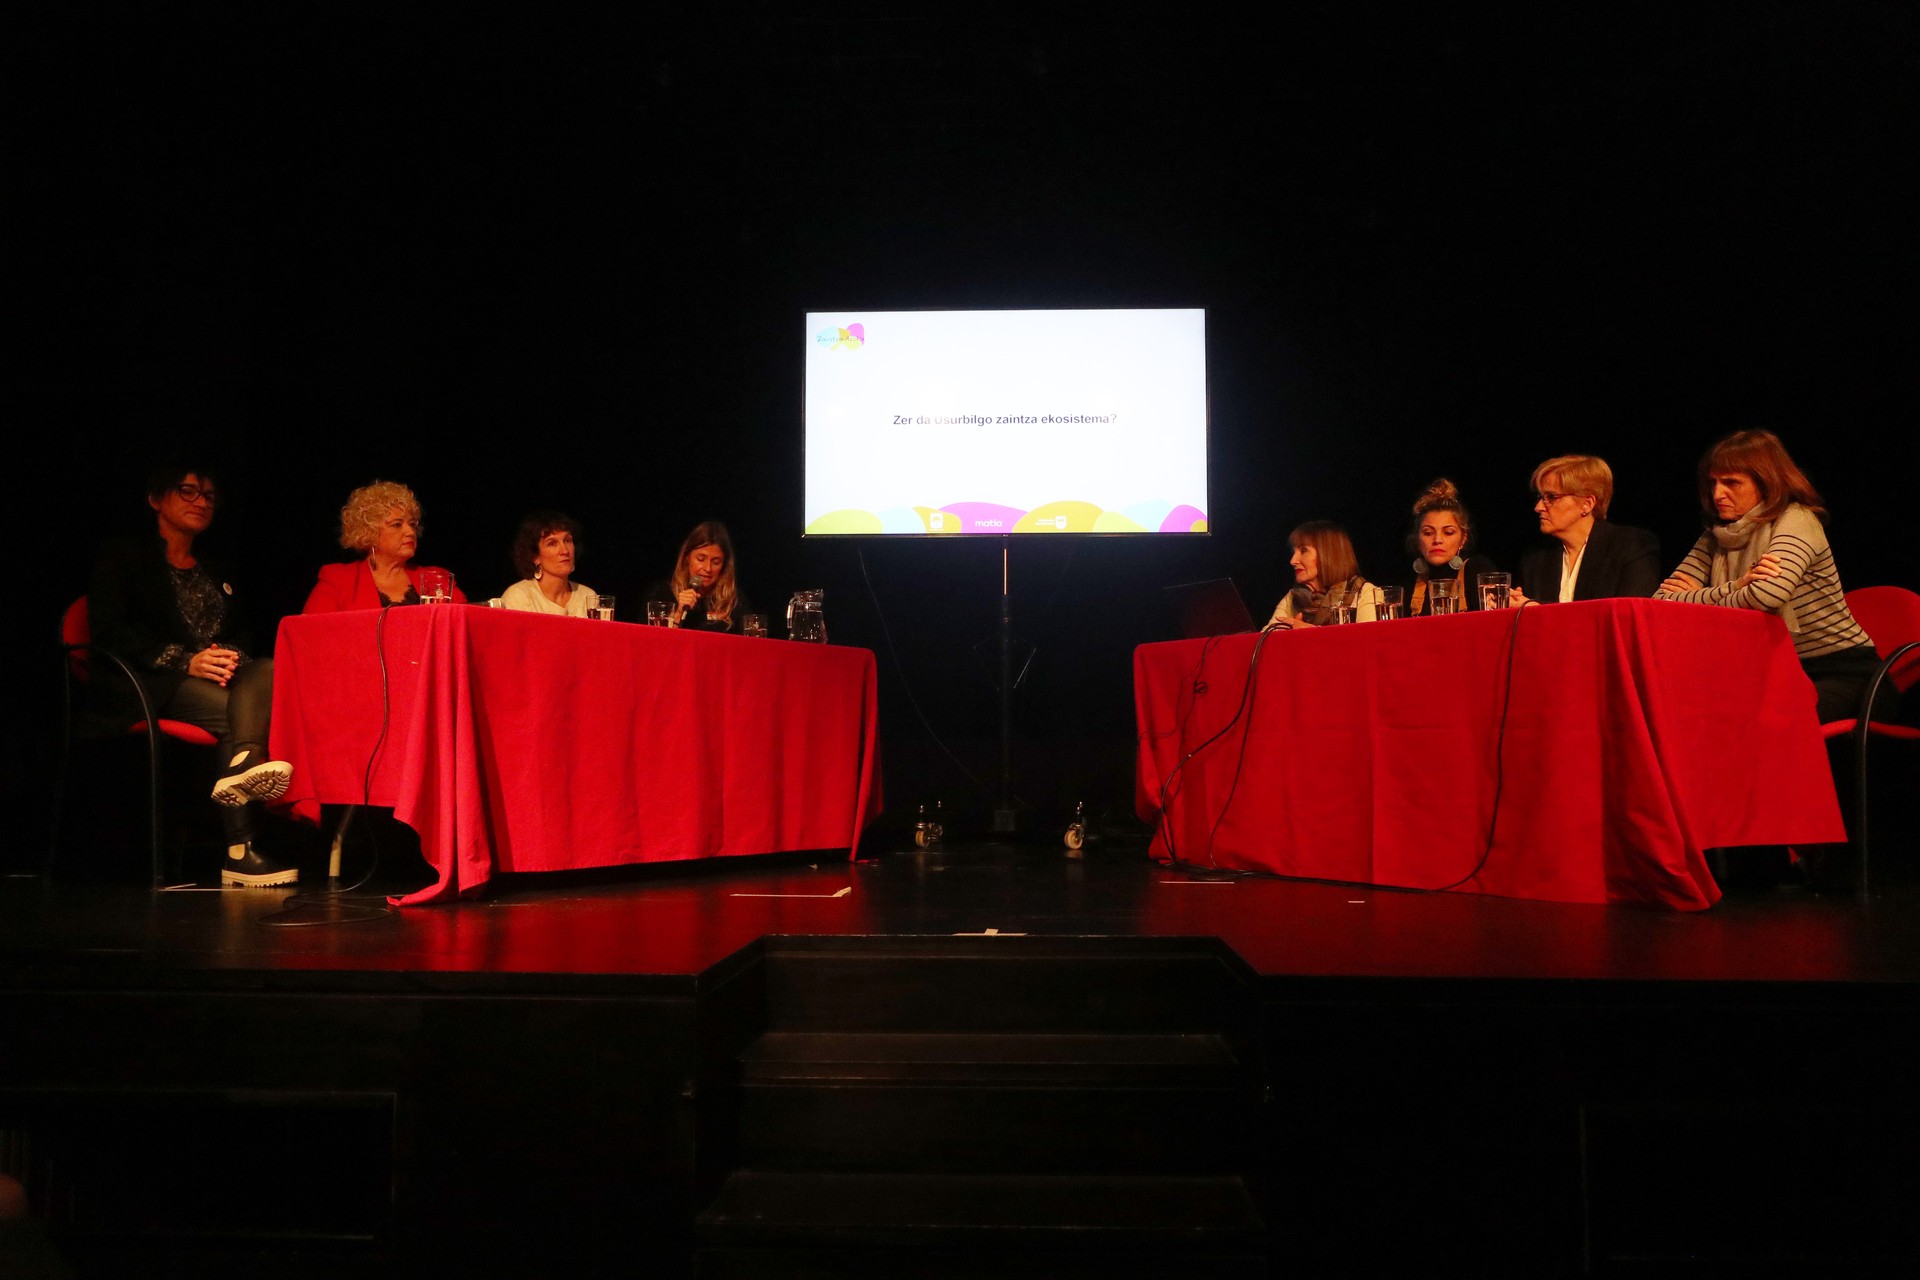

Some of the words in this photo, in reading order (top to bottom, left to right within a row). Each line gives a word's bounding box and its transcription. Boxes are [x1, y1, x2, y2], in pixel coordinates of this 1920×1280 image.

[893, 415, 913, 425] Zer
[916, 415, 931, 425] da
[934, 414, 993, 427] Usurbilgo
[996, 414, 1038, 425] zaintza
[1041, 413, 1118, 424] ekosistema?
[975, 519, 1003, 527] matia
